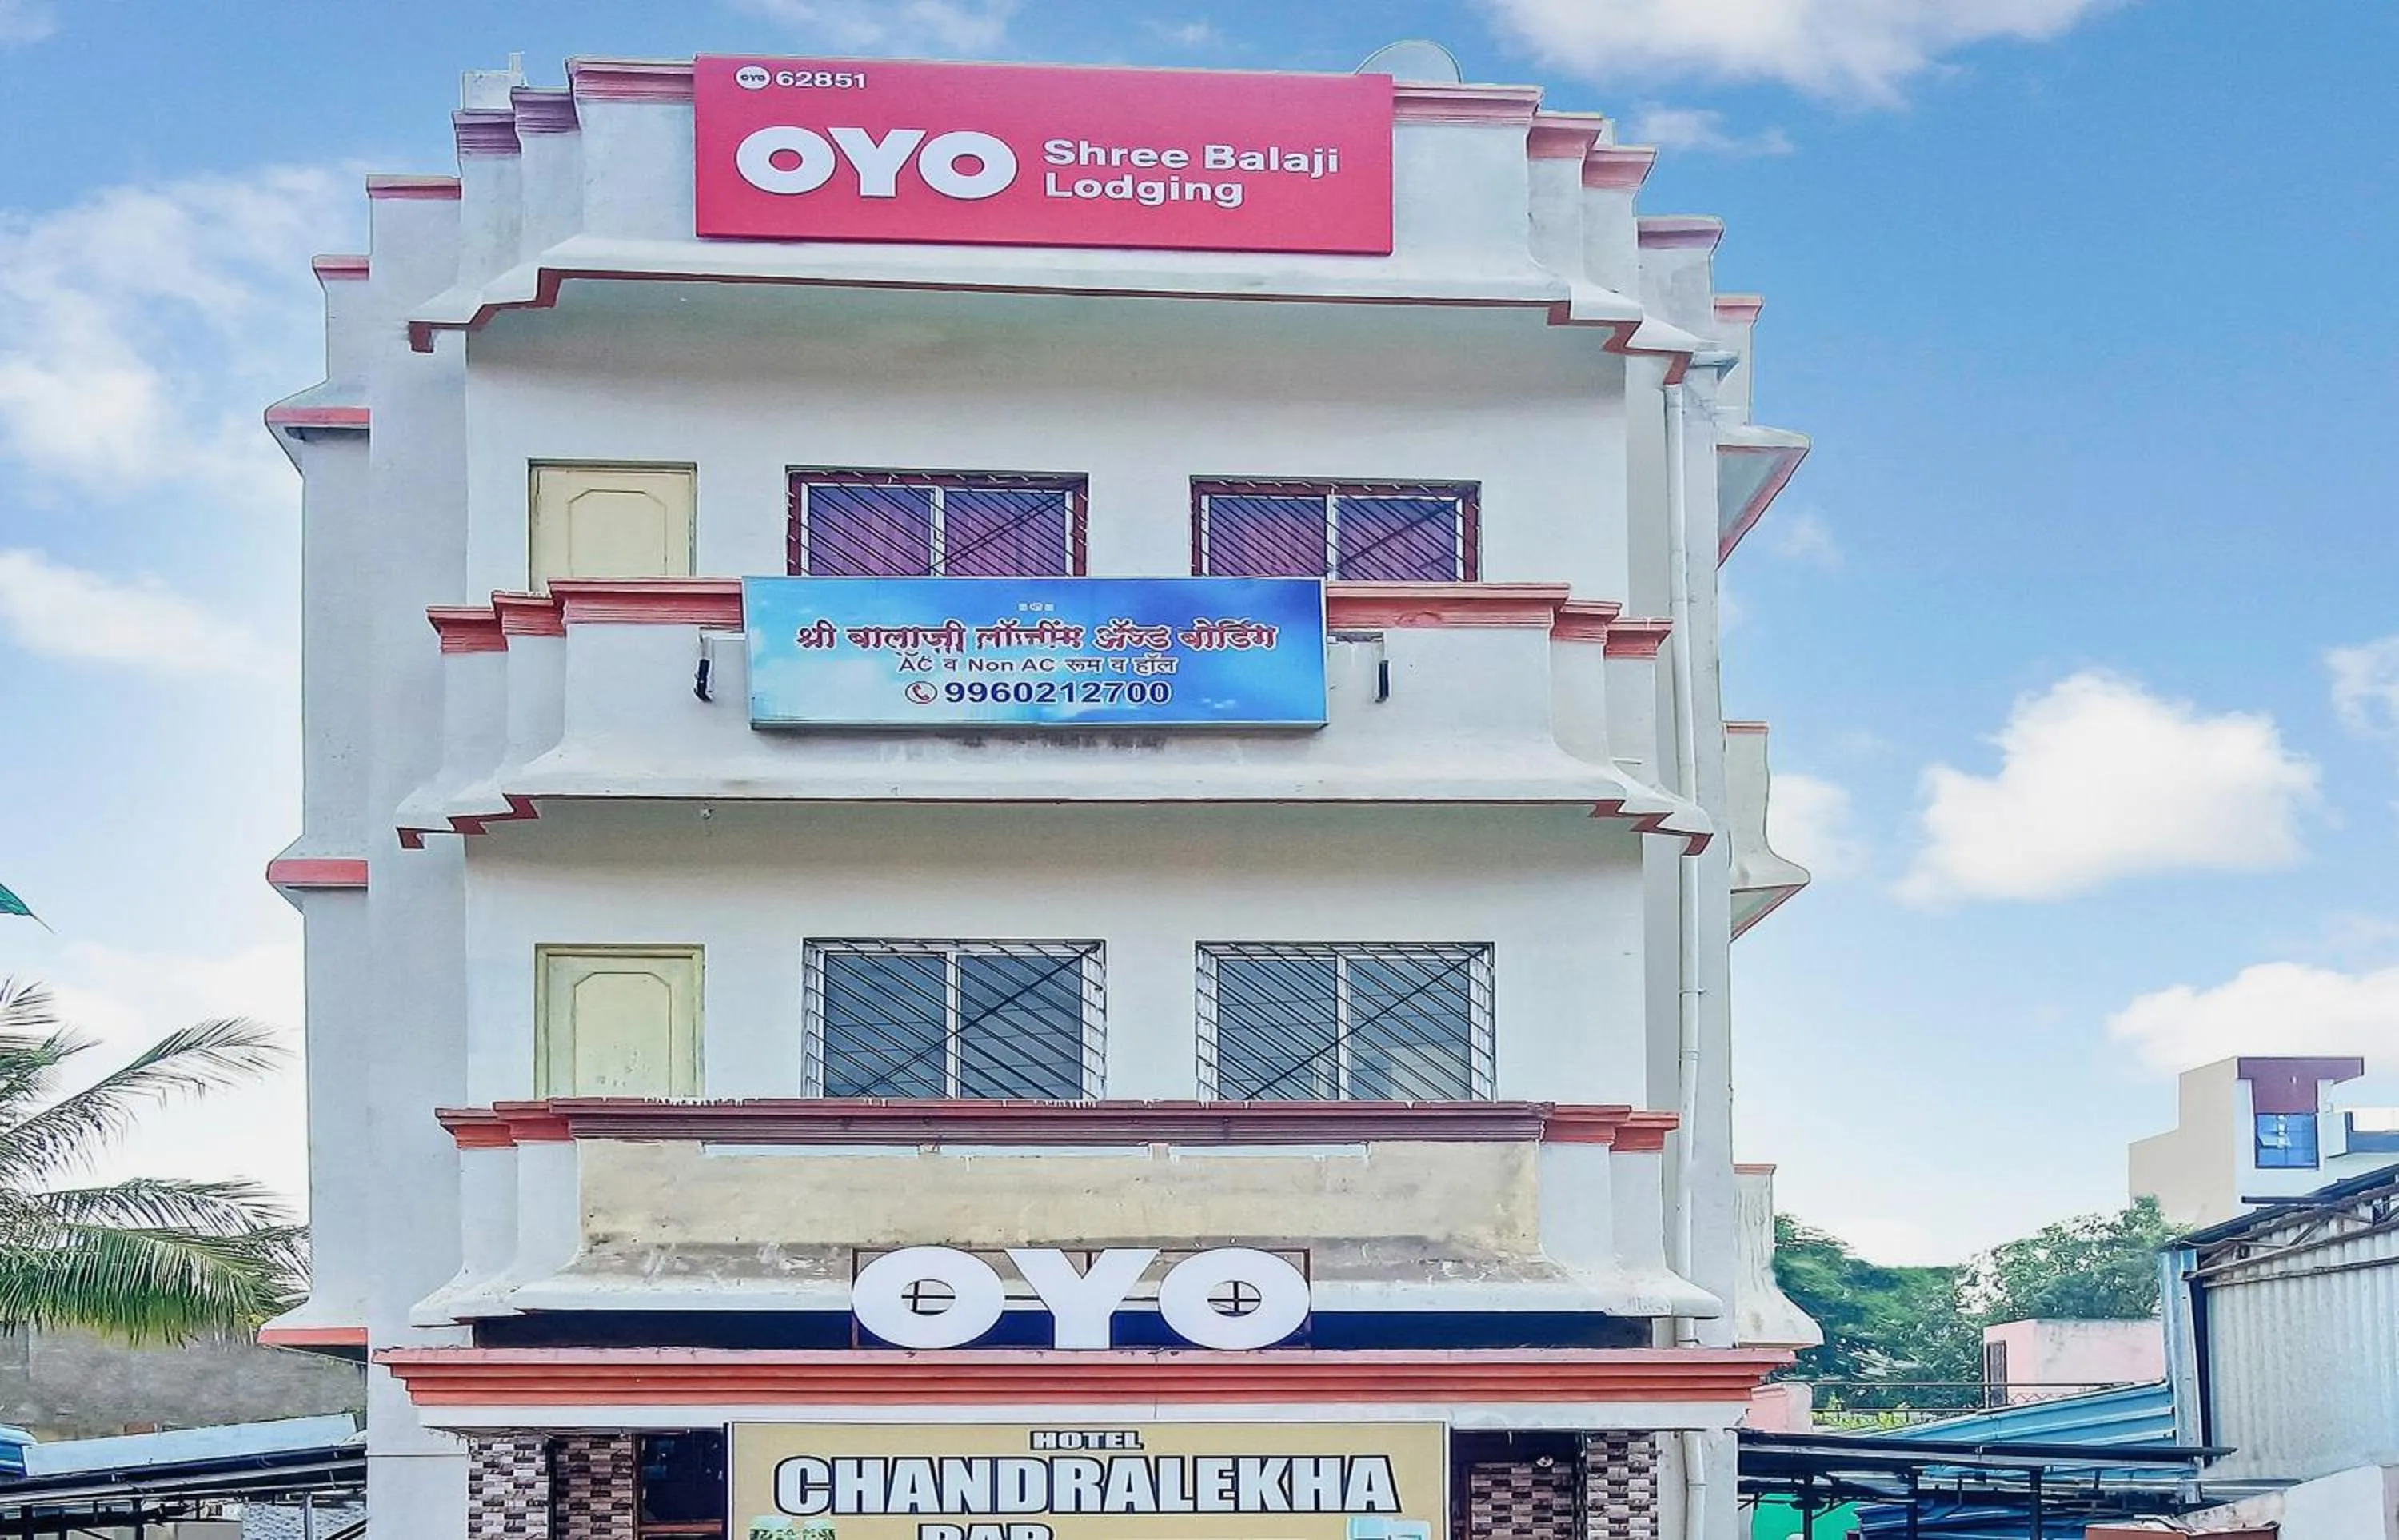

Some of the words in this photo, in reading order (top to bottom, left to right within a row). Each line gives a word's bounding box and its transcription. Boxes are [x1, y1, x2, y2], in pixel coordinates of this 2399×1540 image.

[776, 70, 867, 89] 62851
[736, 126, 1019, 199] OYO
[1042, 138, 1194, 170] Shree
[1203, 143, 1339, 180] Balaji
[1044, 171, 1244, 209] Lodging
[796, 619, 837, 649] श्री
[899, 656, 934, 672] AC
[943, 658, 958, 672] व
[968, 658, 1013, 672] Non
[1021, 658, 1056, 672] AC
[1064, 657, 1102, 673] रूम
[1133, 652, 1178, 675] हॉल
[944, 681, 1171, 704] 9960212700
[852, 1245, 1311, 1350] OYO
[1030, 1430, 1144, 1450] HOTEL
[774, 1455, 1401, 1515] CHANDRALEKHA
